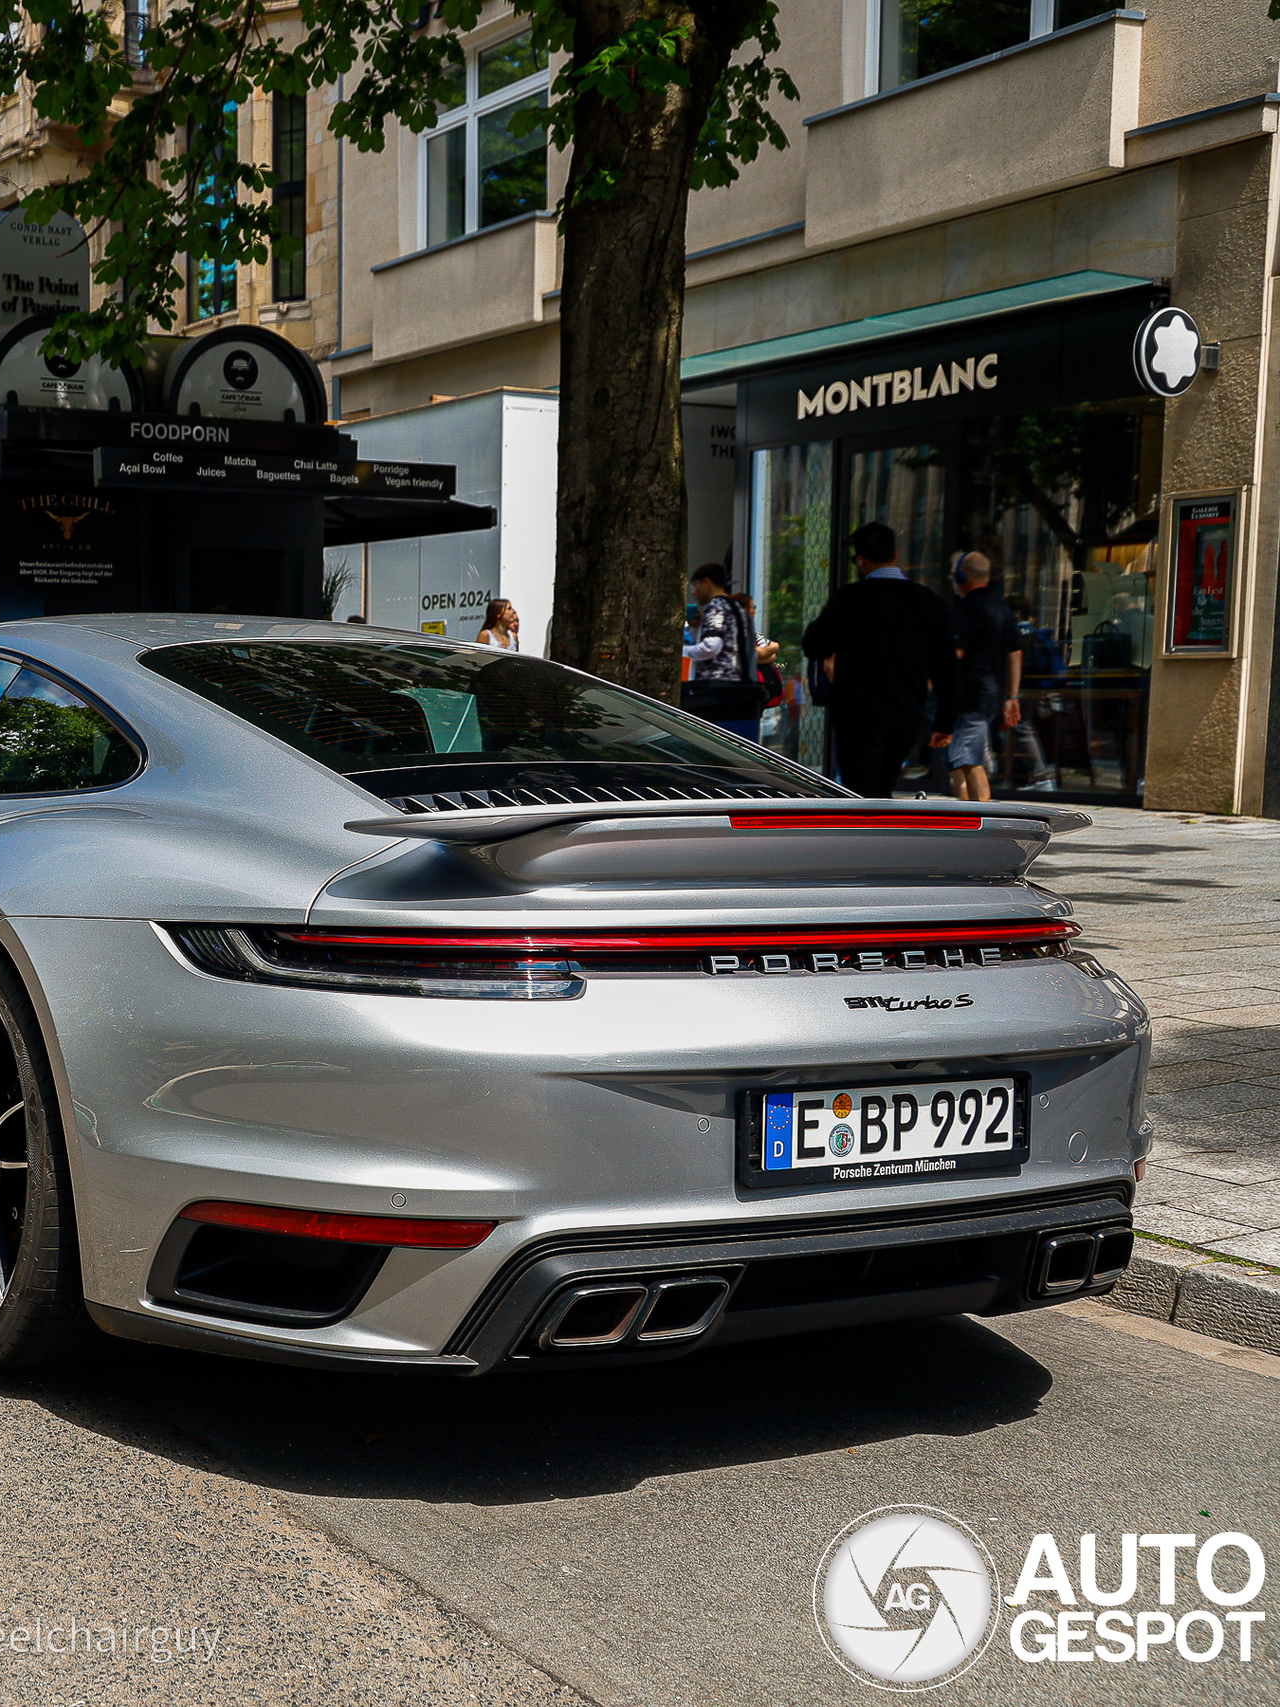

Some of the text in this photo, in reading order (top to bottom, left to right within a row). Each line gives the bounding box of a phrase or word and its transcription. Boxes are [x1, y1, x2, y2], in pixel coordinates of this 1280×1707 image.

[23, 235, 60, 246] VERLAG
[2, 274, 79, 296] The Point
[2, 296, 19, 312] of
[797, 354, 998, 420] MONTBLANC
[130, 422, 230, 442] FOODPORN
[153, 452, 409, 476] Coffee Matcha Chai Latte Porridge
[120, 463, 444, 490] Açai Bowl Juices Baguettes Bagels Vegan friendly
[18, 494, 115, 514] THE GRILL
[422, 589, 491, 610] OPEN 2024
[1194, 586, 1223, 595] Ein Fest
[1192, 605, 1204, 615] die
[1199, 616, 1223, 628] Augen
[710, 948, 1002, 974] PORSCHE
[954, 994, 974, 1008] S
[796, 1086, 1010, 1160] E BP 992
[774, 1140, 784, 1158] D
[833, 1158, 956, 1180] Porsche Zentrum München
